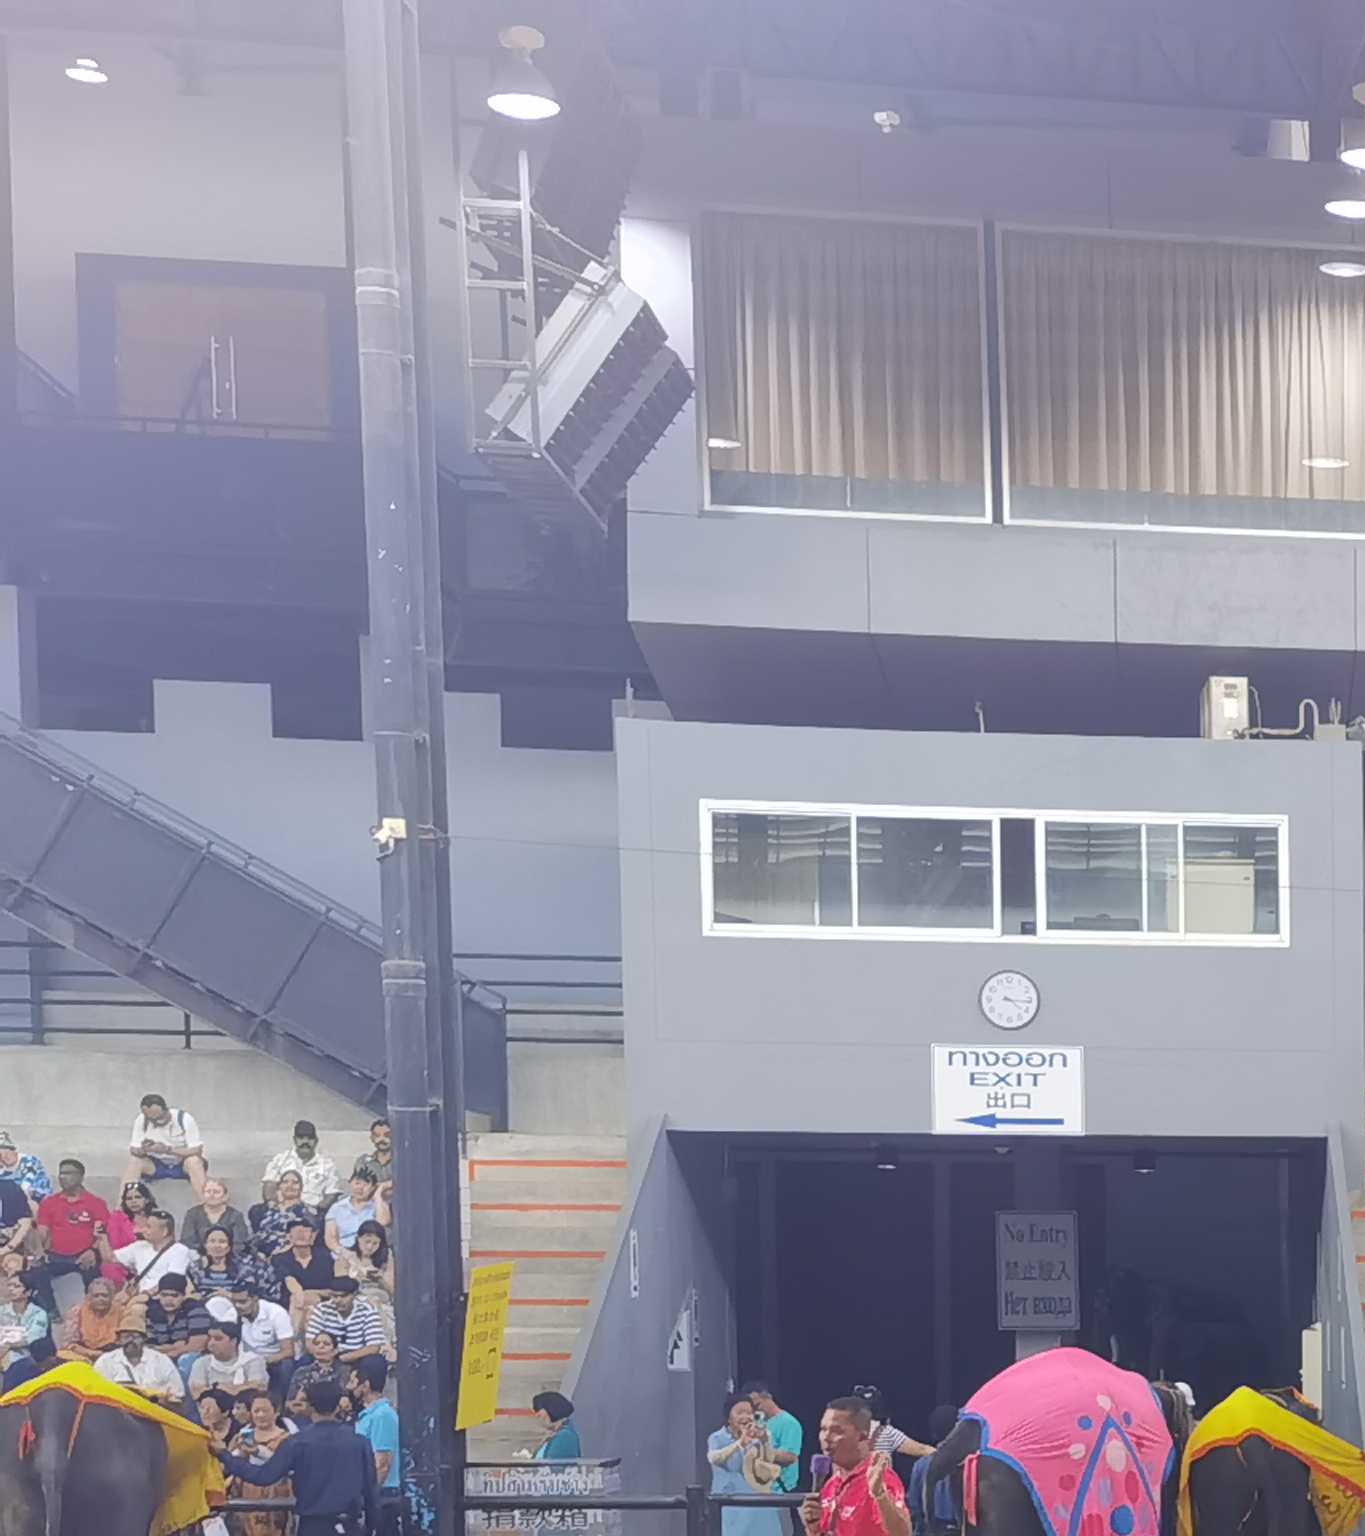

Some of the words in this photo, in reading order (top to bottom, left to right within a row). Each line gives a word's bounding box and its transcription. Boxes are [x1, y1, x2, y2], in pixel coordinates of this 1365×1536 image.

[948, 1050, 1068, 1068] ทางออก
[969, 1071, 1047, 1087] EXIT
[986, 1091, 1032, 1109] 出口
[1003, 1223, 1025, 1242] No
[1029, 1222, 1068, 1248] Entry
